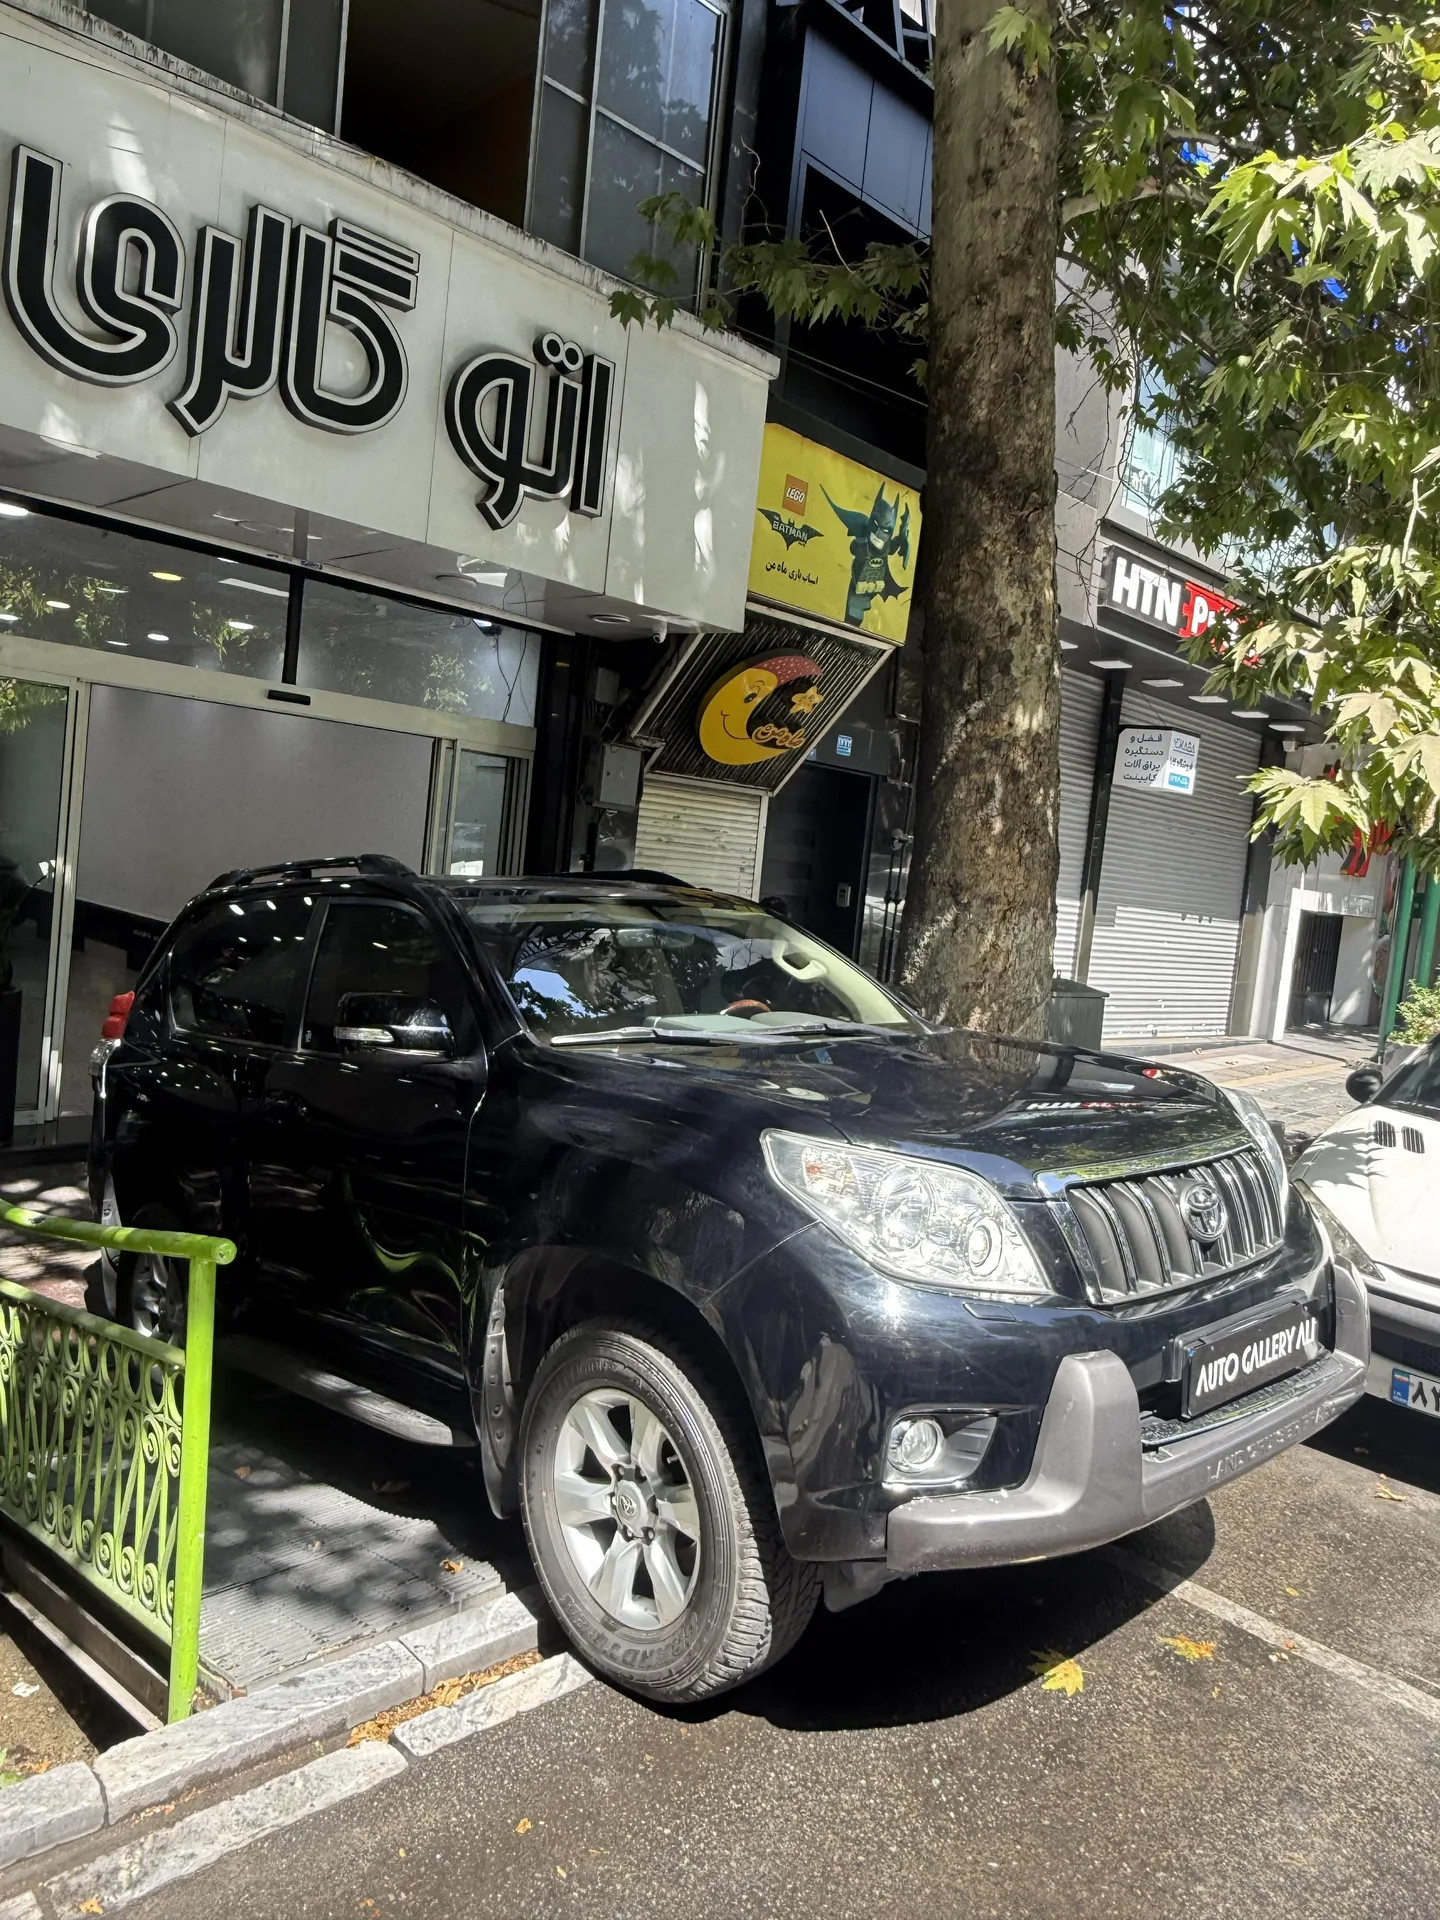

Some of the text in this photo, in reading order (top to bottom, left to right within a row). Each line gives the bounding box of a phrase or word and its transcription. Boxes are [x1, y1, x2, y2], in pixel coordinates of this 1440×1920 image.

[2, 144, 616, 531] اتو گالری
[786, 487, 805, 503] LEGO
[772, 521, 808, 542] BATMAN
[1112, 556, 1182, 627] HTN
[1124, 746, 1164, 757] دستگیره
[1195, 1352, 1240, 1397] AUTO
[1241, 1325, 1296, 1375] GALLERY
